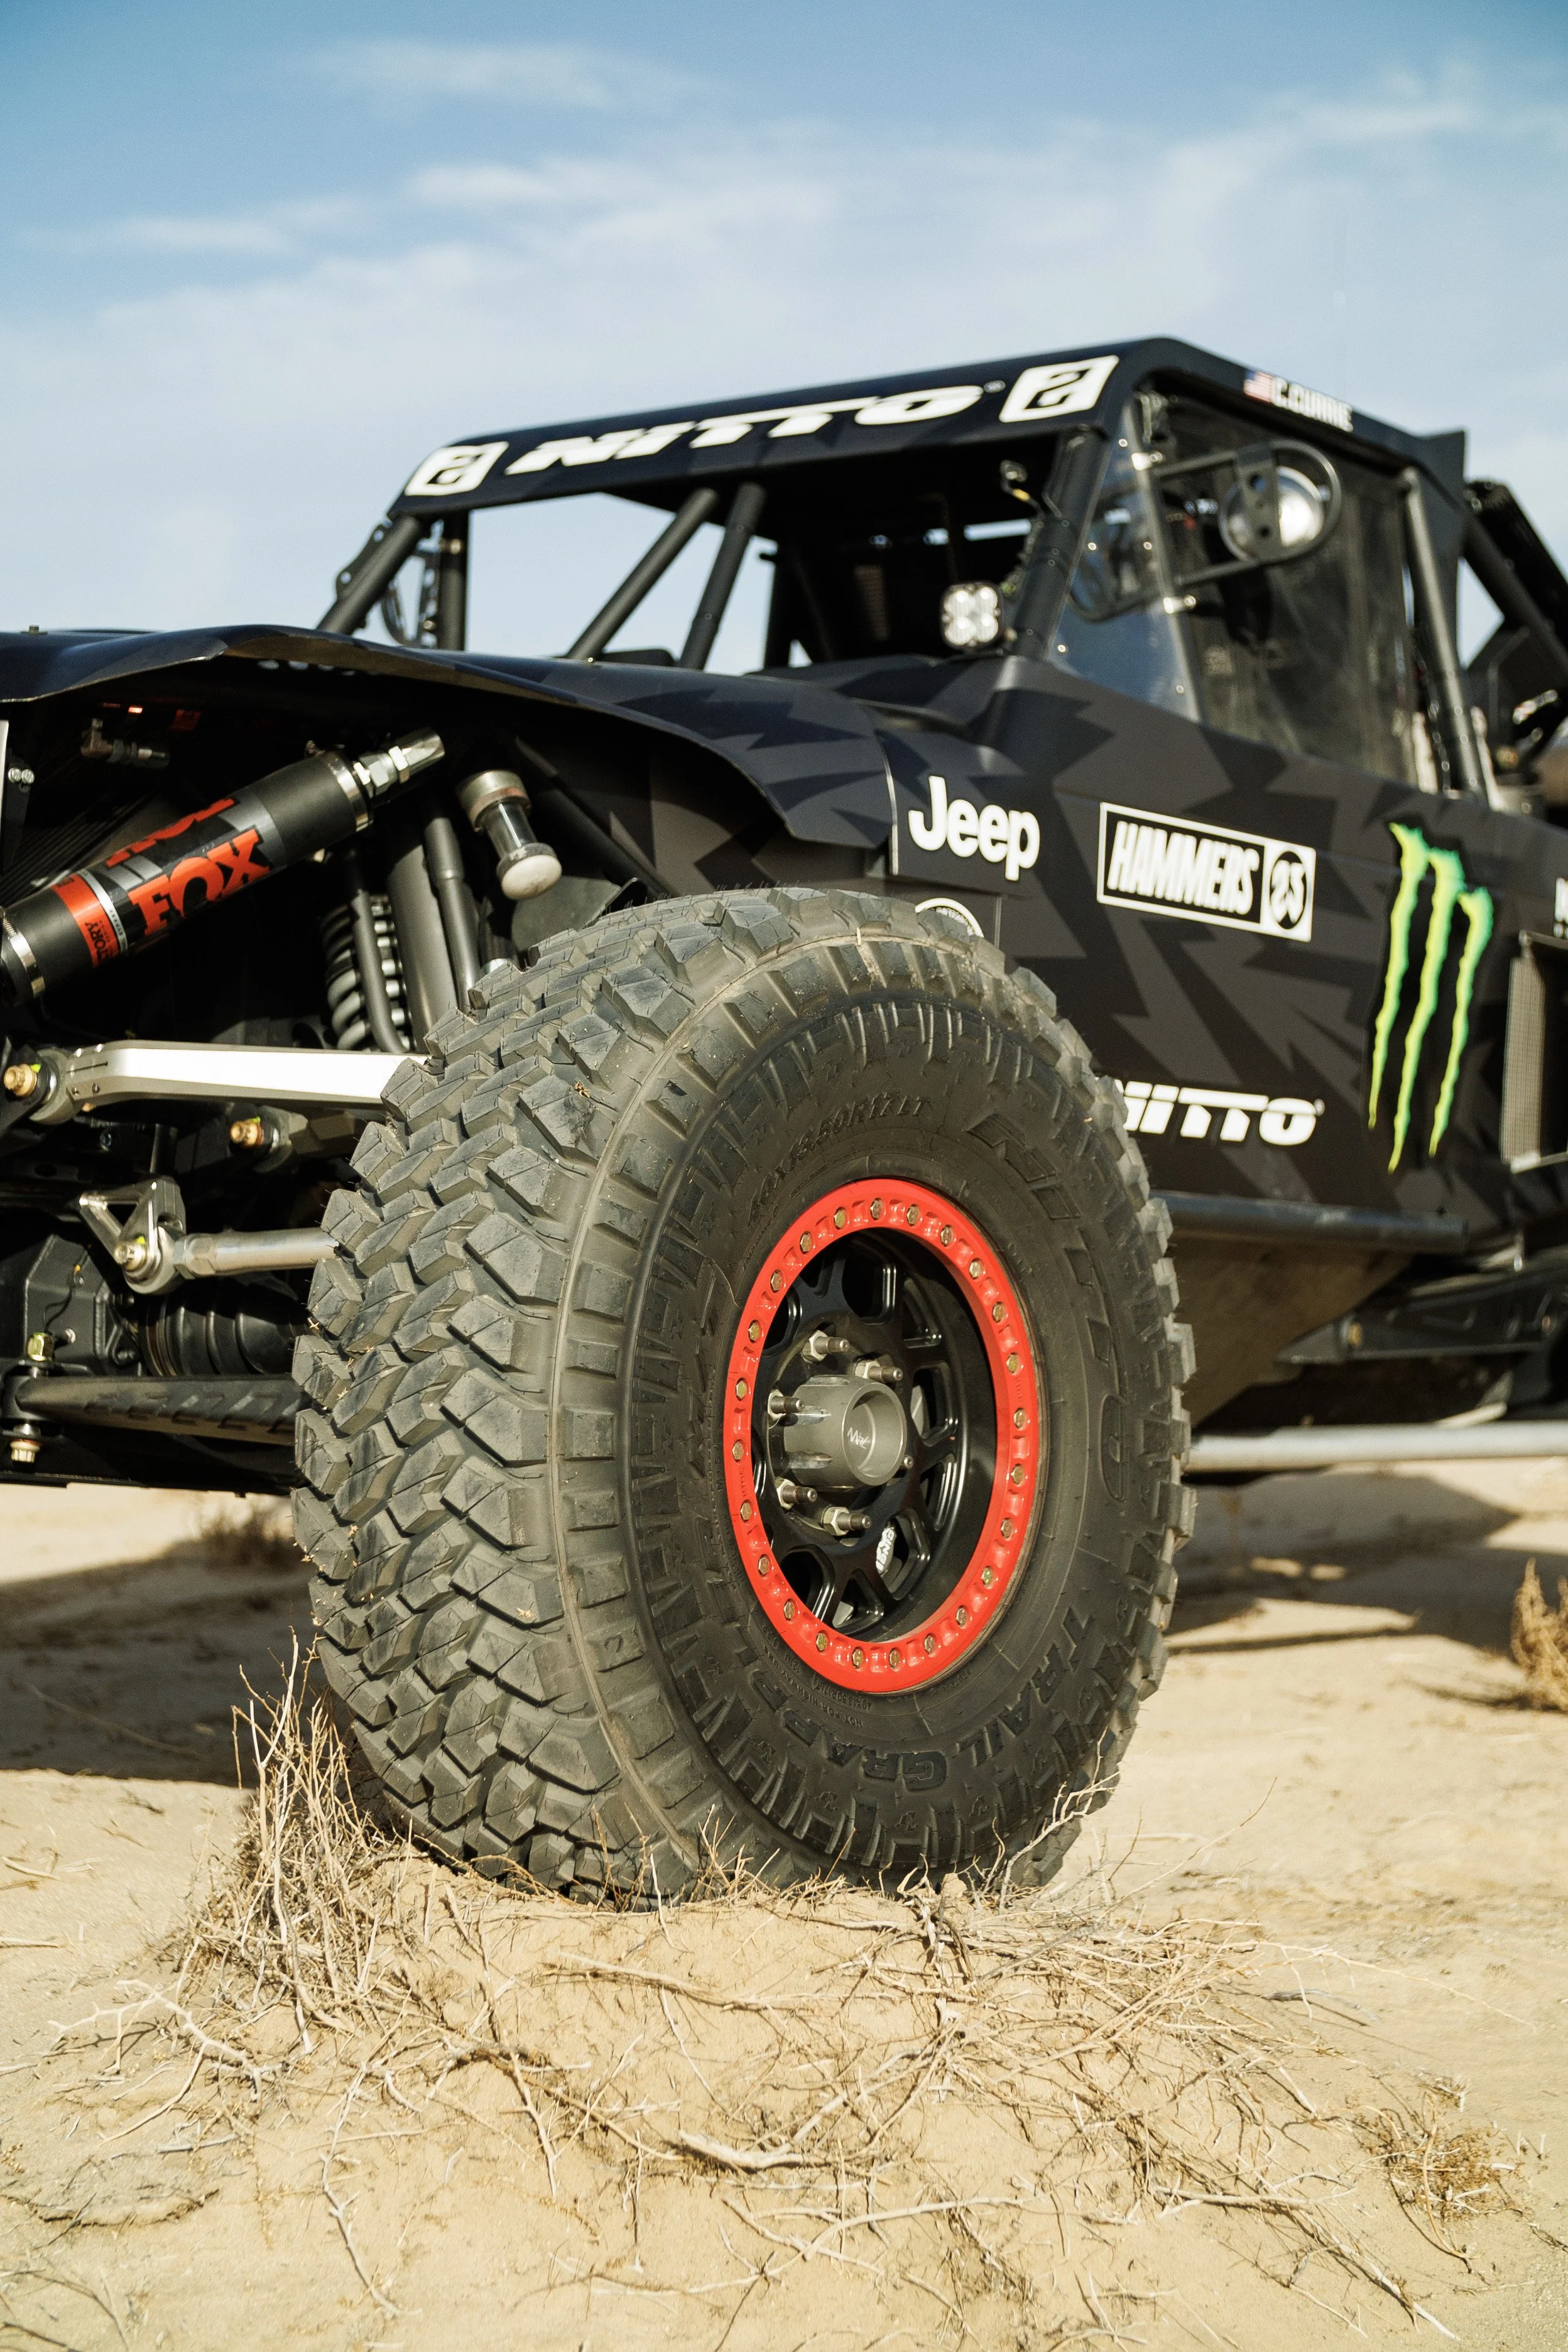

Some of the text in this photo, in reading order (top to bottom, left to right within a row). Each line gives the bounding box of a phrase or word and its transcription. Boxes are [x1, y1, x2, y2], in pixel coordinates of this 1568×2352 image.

[504, 385, 983, 475] NITTO
[908, 775, 1040, 881] Jeep
[1107, 820, 1260, 915] HAMMERS
[128, 829, 270, 935] FOX
